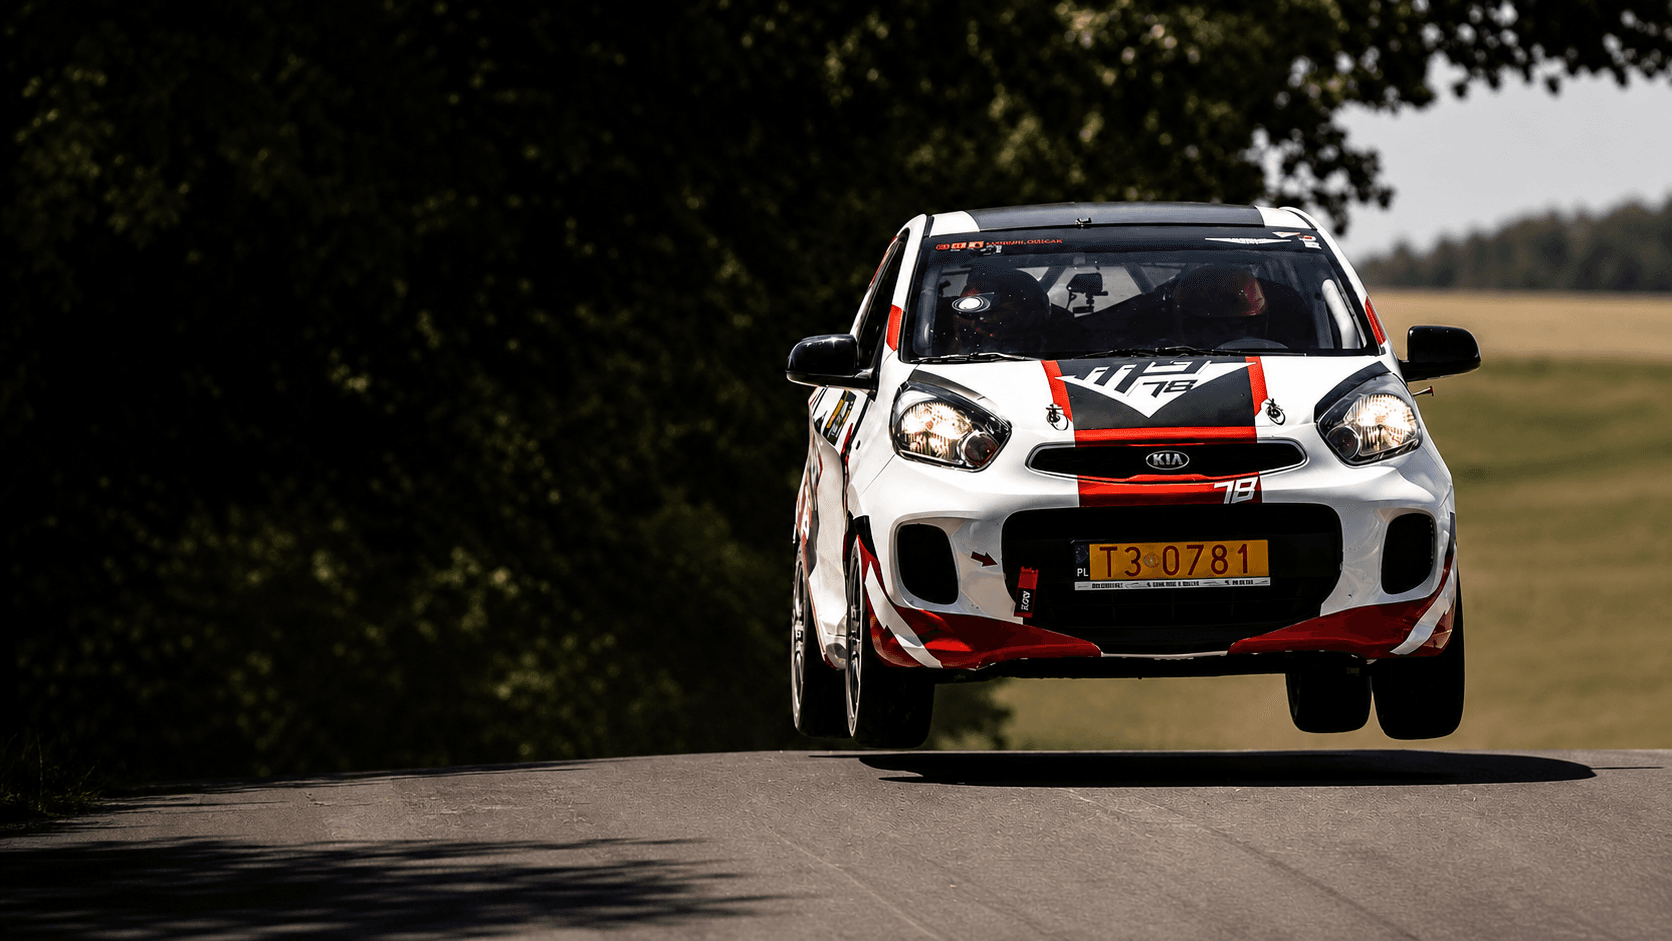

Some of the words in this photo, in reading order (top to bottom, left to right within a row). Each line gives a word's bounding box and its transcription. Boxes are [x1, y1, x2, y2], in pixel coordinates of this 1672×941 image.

[1143, 379, 1198, 398] 78
[1153, 453, 1183, 465] KIA
[1213, 476, 1259, 504] 78
[1099, 546, 1142, 577] T3
[1162, 543, 1249, 576] 0781
[1076, 567, 1089, 577] PL
